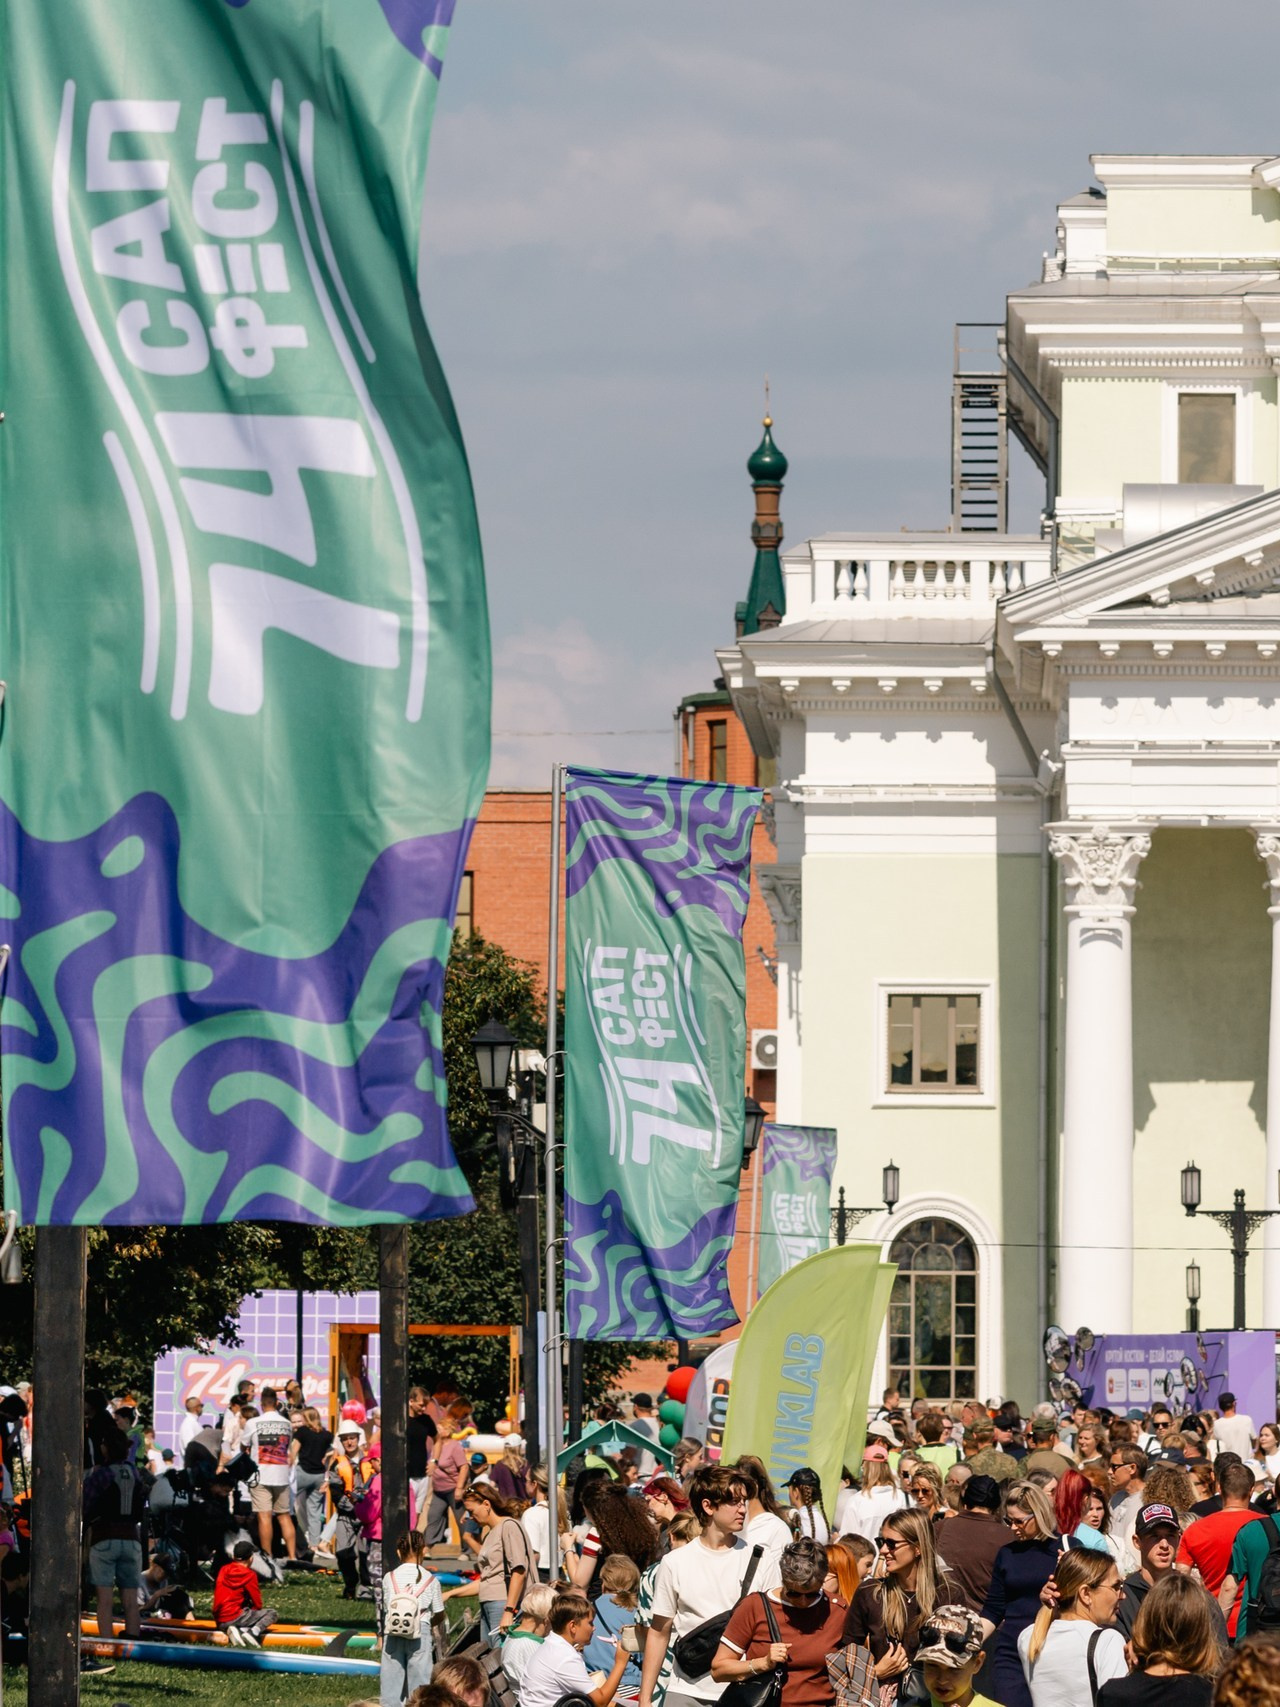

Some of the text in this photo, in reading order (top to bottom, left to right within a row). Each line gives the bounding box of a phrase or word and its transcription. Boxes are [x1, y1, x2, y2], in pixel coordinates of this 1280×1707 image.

[86, 100, 210, 376] САП
[192, 97, 308, 379] ФЕСТ
[154, 412, 400, 714] 74
[591, 946, 636, 1045] САП
[631, 948, 677, 1048] ФЕСТ
[614, 1056, 712, 1165] 74
[776, 1193, 793, 1233] САП
[186, 1362, 246, 1405] 74
